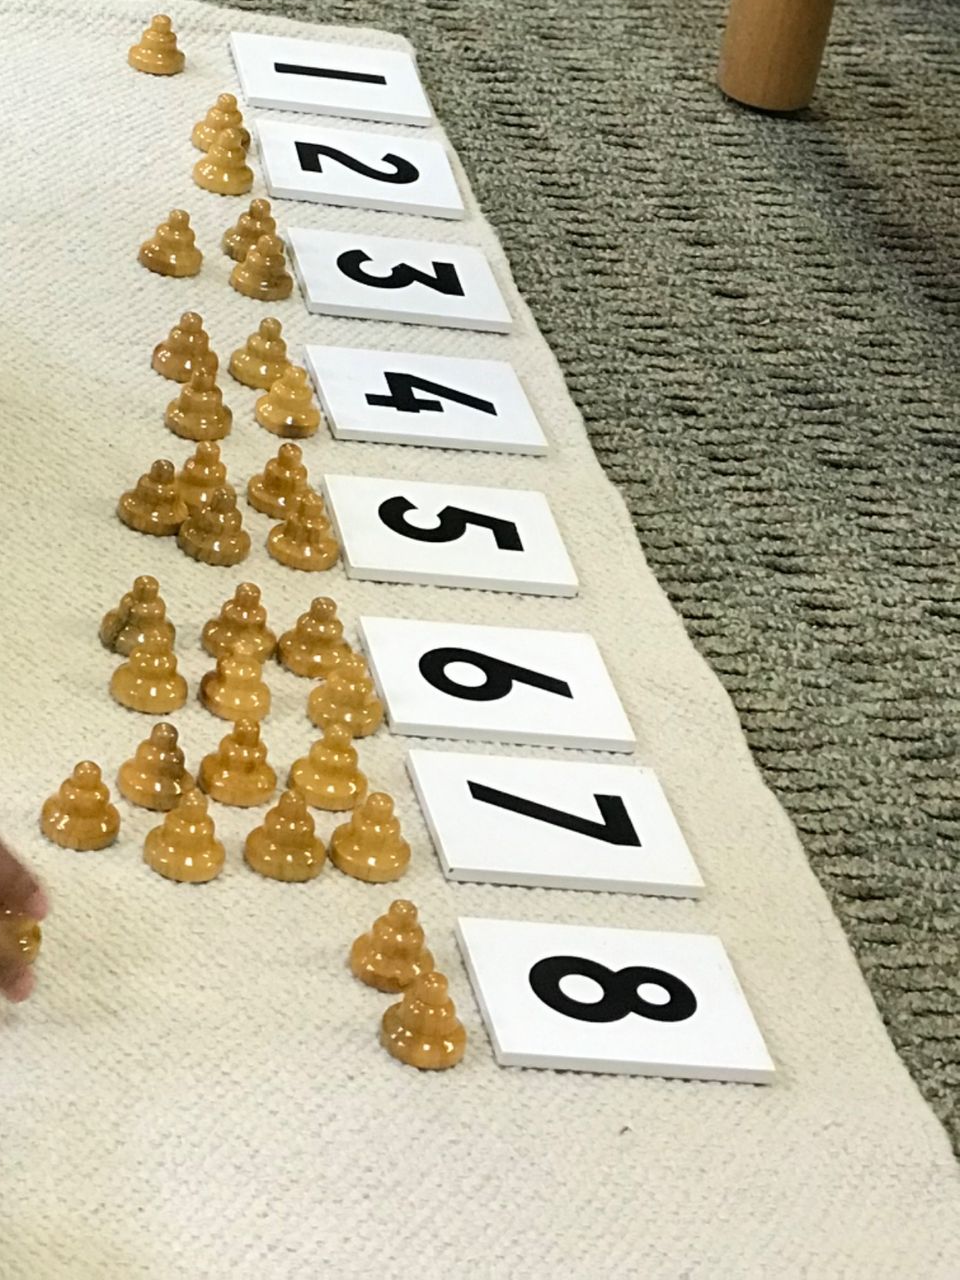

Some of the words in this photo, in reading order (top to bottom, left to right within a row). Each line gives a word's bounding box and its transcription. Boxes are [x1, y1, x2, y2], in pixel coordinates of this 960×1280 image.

[274, 62, 386, 85] 1
[295, 141, 420, 185] 2
[336, 249, 465, 297] 3
[365, 371, 498, 416] 4
[377, 495, 524, 552] 5
[418, 647, 574, 702] 6
[466, 780, 642, 847] 7
[528, 955, 698, 1023] 8
